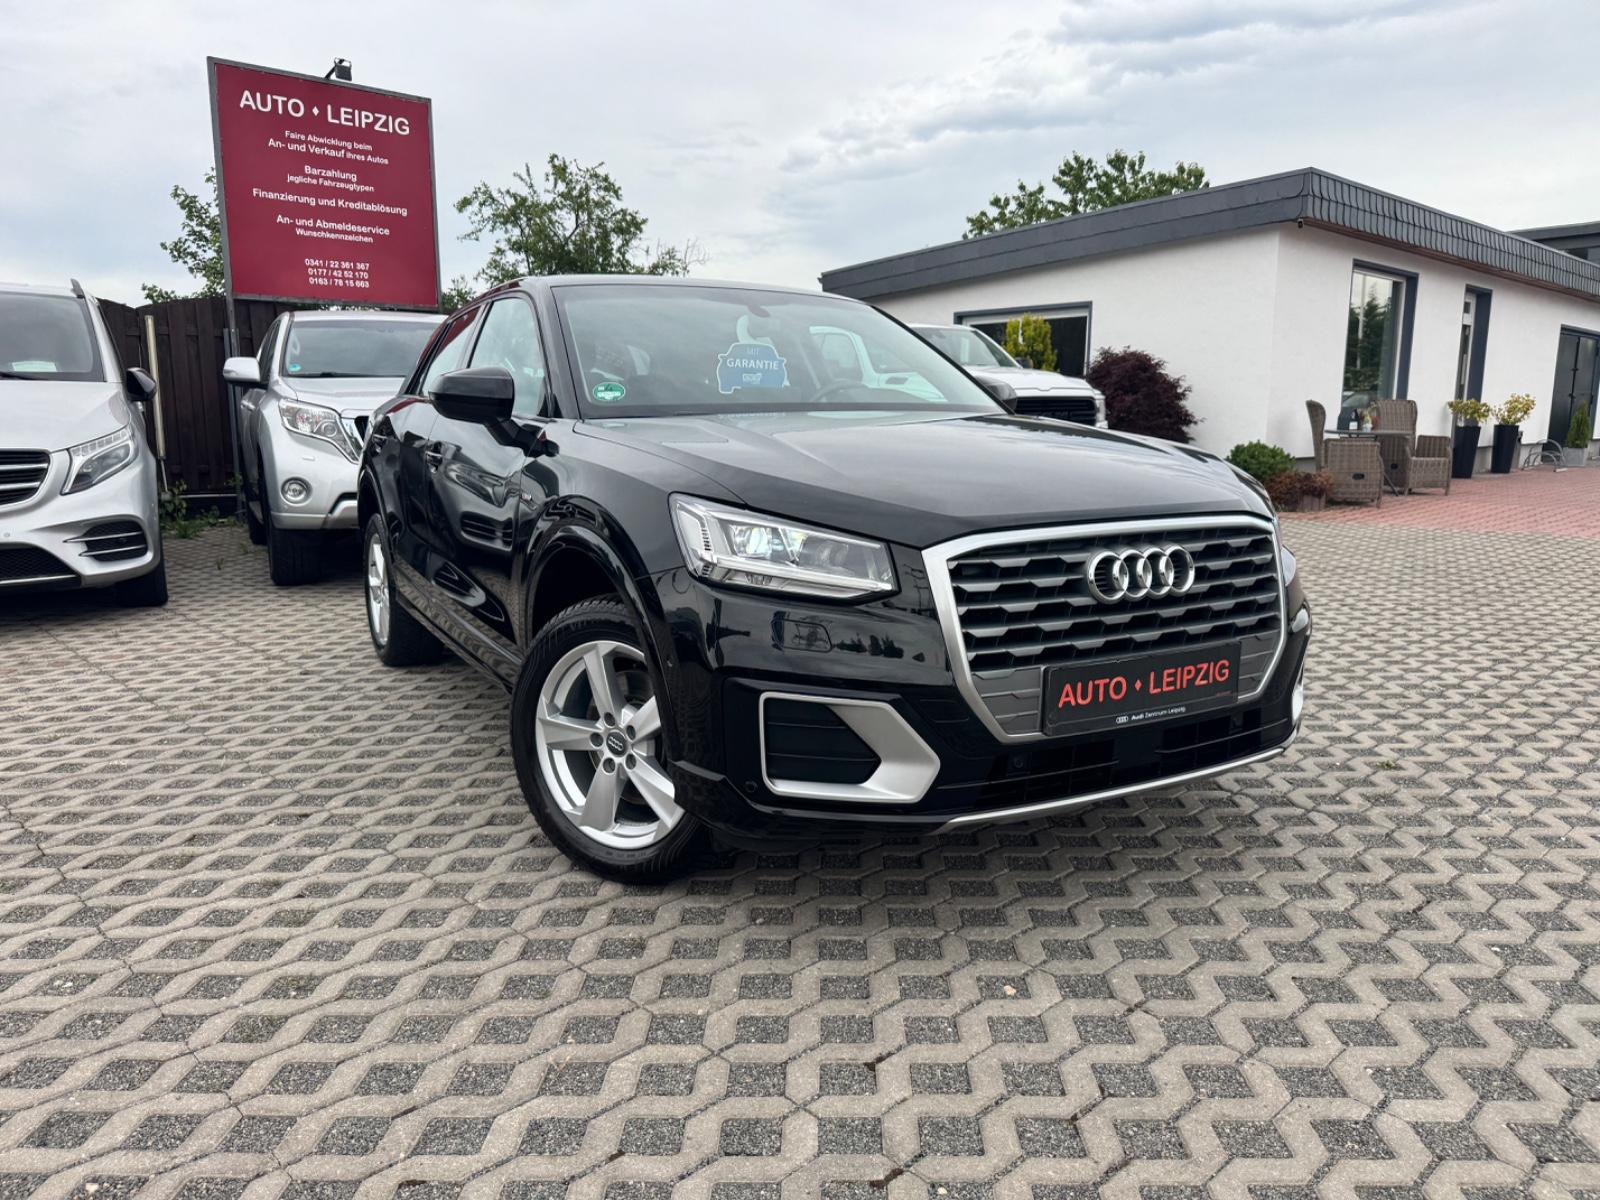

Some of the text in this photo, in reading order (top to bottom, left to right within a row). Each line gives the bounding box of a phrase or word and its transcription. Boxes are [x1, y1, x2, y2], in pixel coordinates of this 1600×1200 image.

[239, 90, 410, 135] AUTO LEIPZIG
[285, 130, 373, 151] Faire Abwicklung beim
[268, 138, 286, 149] An-
[287, 143, 306, 153] und
[308, 145, 345, 159] Verkauf
[367, 156, 389, 165] Autos
[287, 173, 375, 193] jegliche Fahrzeugtypen
[304, 165, 357, 181] Barzahlung
[252, 188, 408, 217] Finanzierung und Kreditablösung
[276, 214, 391, 236] An- und Abmeldeservice
[296, 227, 374, 244] Wunschkennzeichen
[305, 258, 324, 267] 0341
[330, 260, 340, 268] 22
[308, 268, 327, 276] 0177
[333, 270, 343, 278] 42
[726, 358, 780, 370] GARANTIE
[1058, 659, 1231, 709] AUTO LEIPZIG
